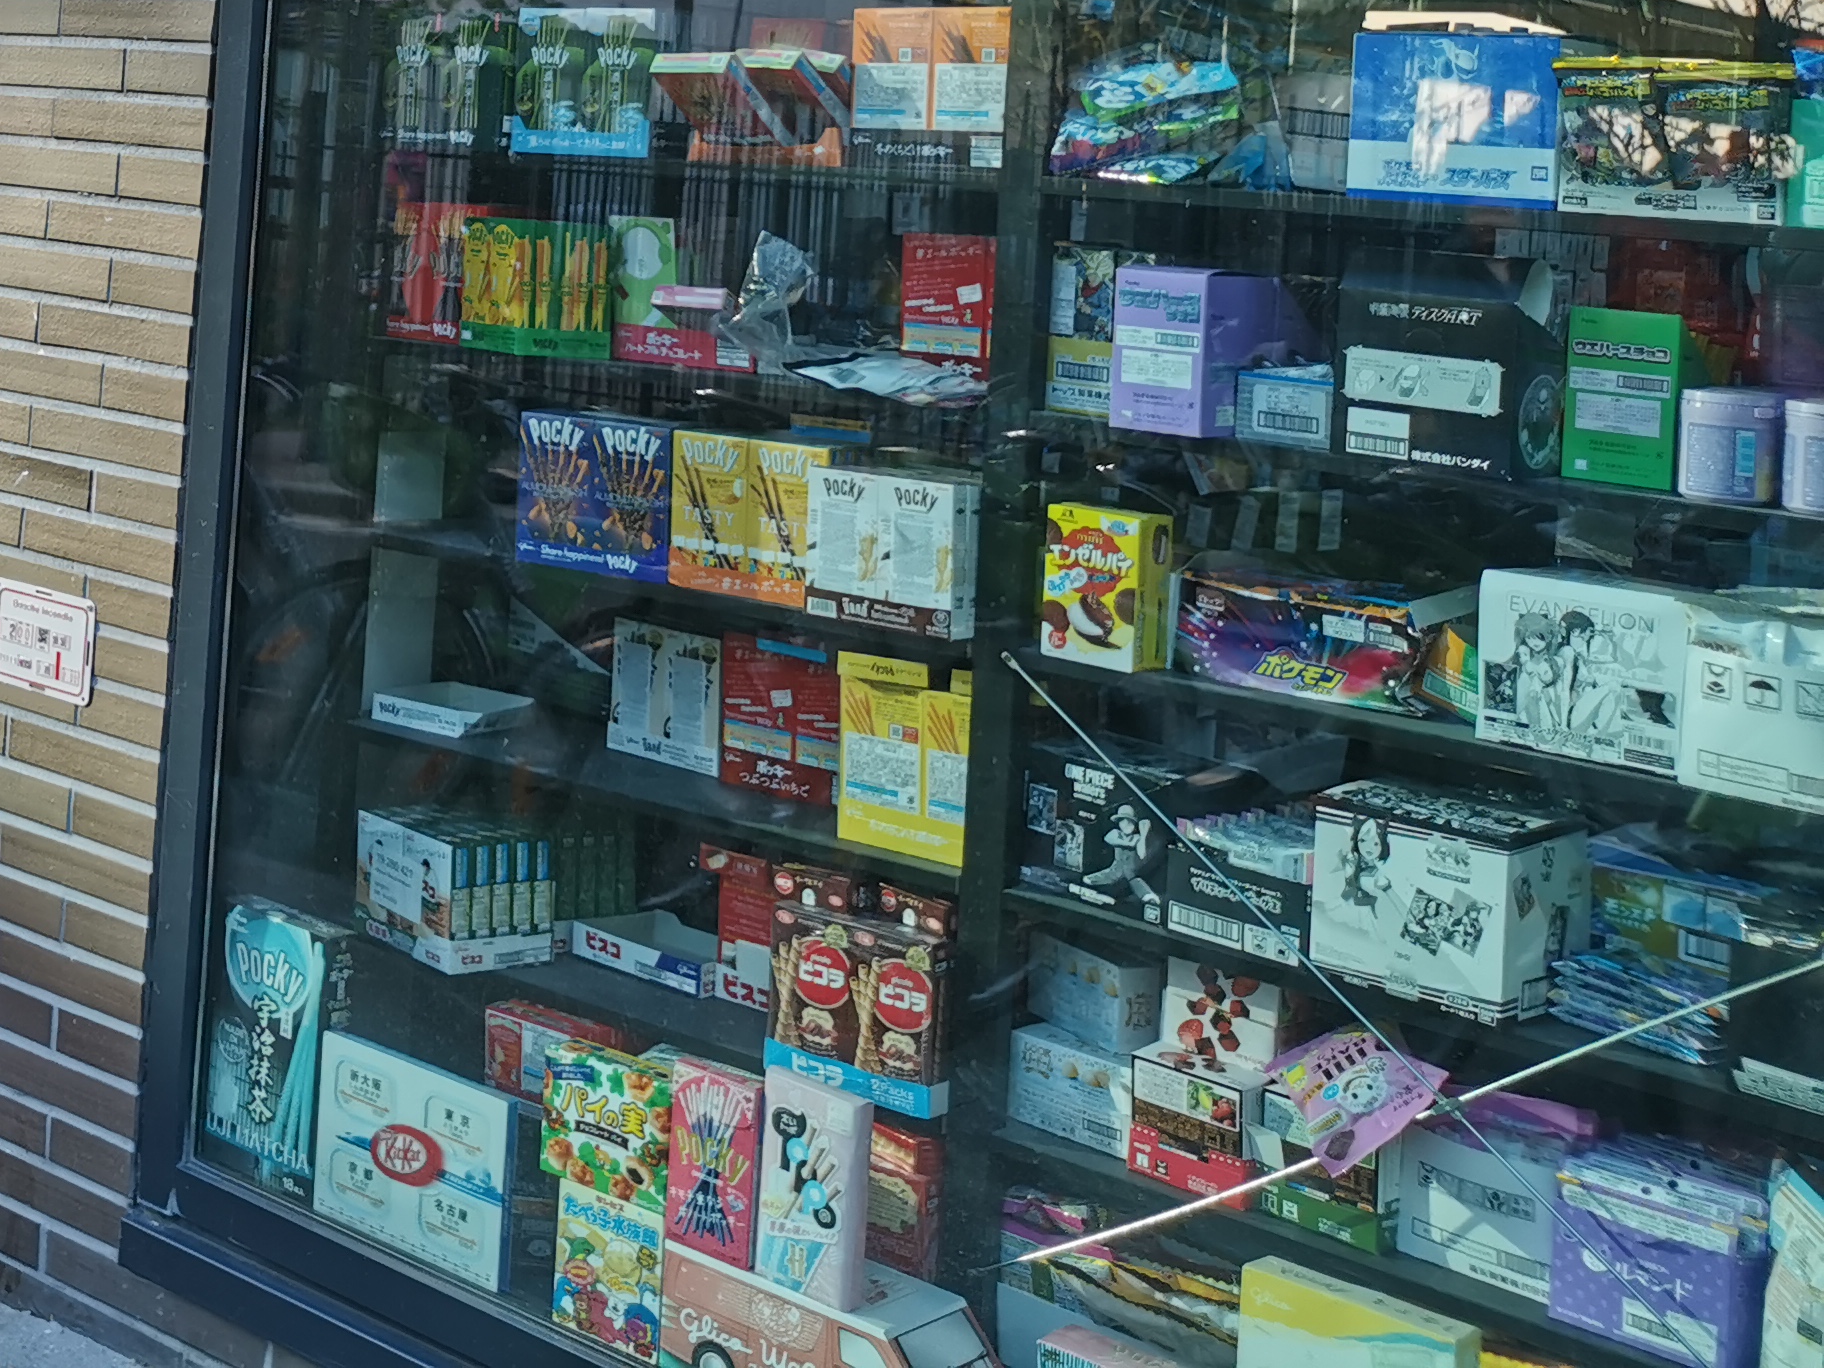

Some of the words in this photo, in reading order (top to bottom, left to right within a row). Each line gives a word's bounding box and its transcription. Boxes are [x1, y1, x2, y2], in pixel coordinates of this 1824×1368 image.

[1572, 338, 1671, 364] ウエハースチョコ
[1411, 449, 1493, 471] 株式会社バンダイ
[683, 505, 736, 527] TASTY
[1049, 543, 1134, 577] エンゼルパイ
[1256, 654, 1349, 690] ポケモン
[739, 771, 812, 799] つぶつぶいちご
[755, 759, 793, 779] ポッキー
[585, 929, 622, 961] ビスコ
[722, 971, 771, 1010] ビスコ
[798, 960, 846, 990] ピコラ
[878, 982, 928, 1014] ピコラ
[247, 992, 278, 1126] 宇治抹茶
[790, 1051, 845, 1088] ピコラ
[349, 1069, 383, 1093] 新大阪
[561, 1082, 647, 1140] パイの実
[239, 1123, 311, 1176] MATCHA
[383, 1134, 422, 1172] KitKat
[434, 1196, 469, 1225] 名古屋
[562, 1192, 661, 1251] たべっ子水族館
[679, 1307, 753, 1356] Glico
